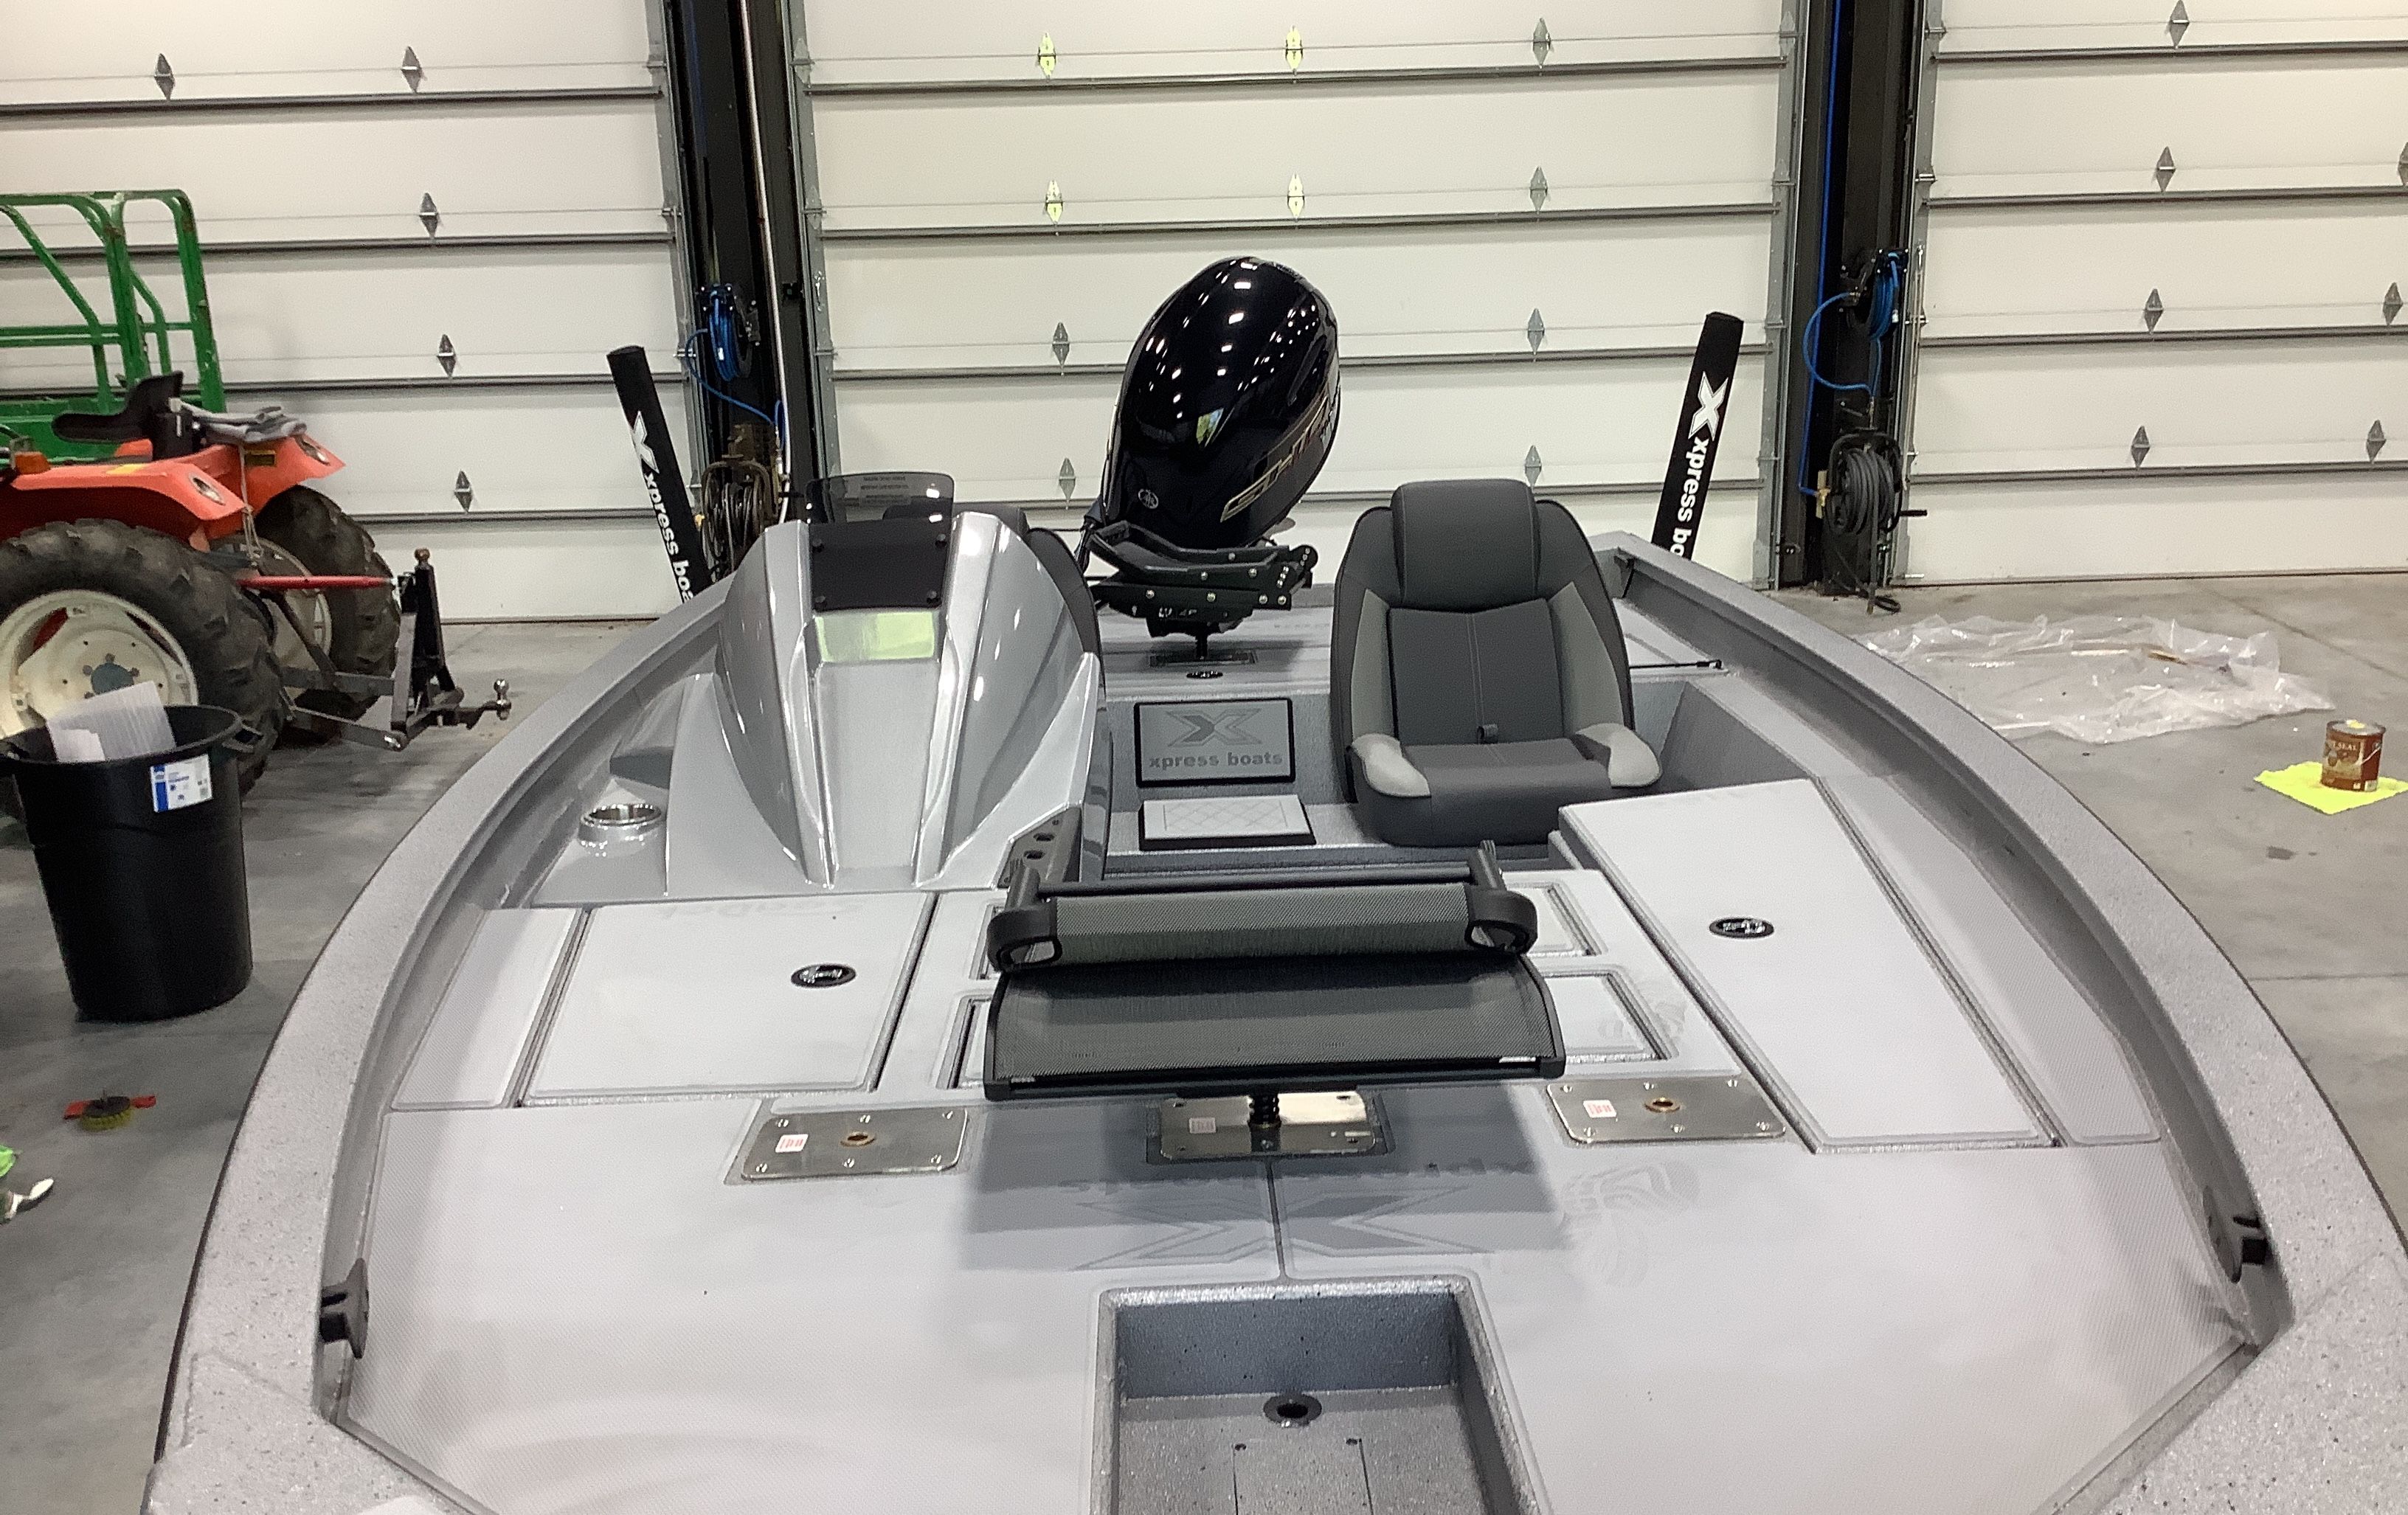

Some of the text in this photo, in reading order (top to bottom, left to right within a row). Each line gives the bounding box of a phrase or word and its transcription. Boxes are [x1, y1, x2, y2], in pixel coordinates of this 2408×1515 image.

[643, 471, 679, 555] xpress
[1678, 436, 1710, 523] xpress
[1149, 752, 1284, 771] xpress boats
